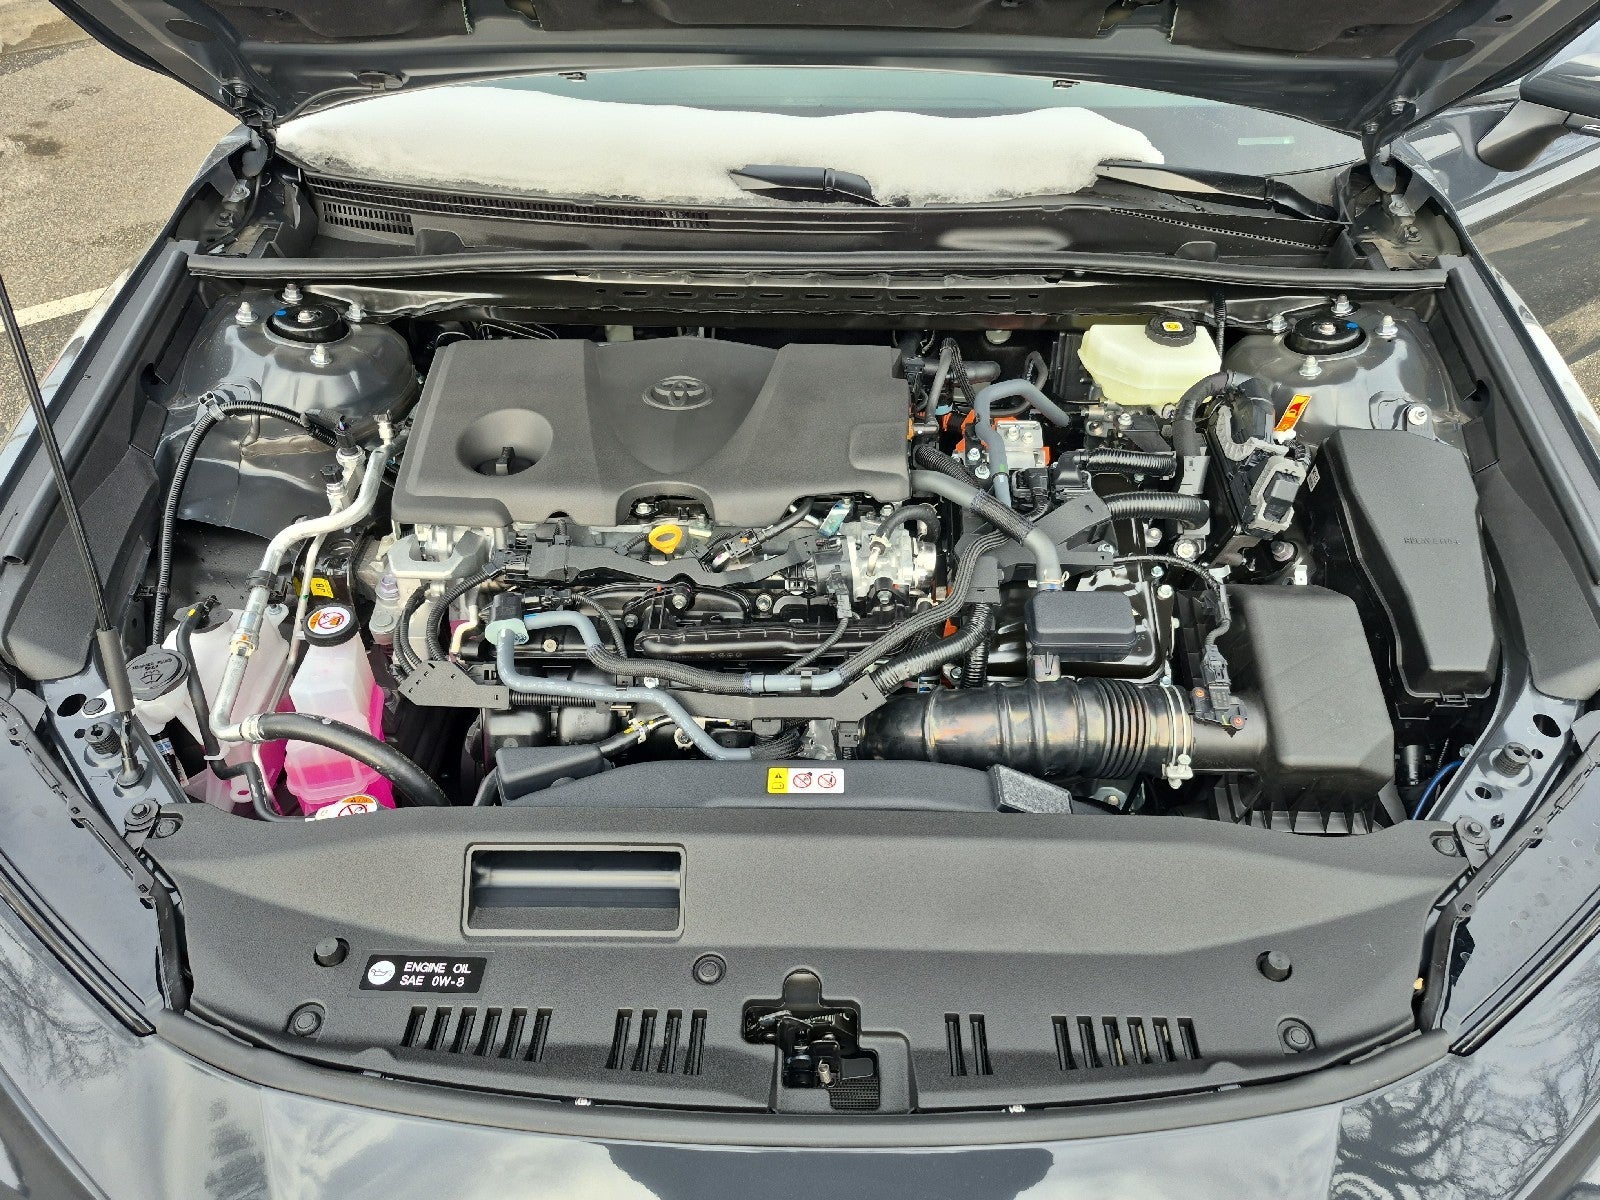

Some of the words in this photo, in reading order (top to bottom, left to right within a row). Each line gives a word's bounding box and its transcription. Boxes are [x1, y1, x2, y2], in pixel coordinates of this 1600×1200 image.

[404, 961, 447, 974] ENGINE
[452, 963, 472, 974] OIL
[399, 974, 425, 986] SAE
[431, 976, 465, 987] 0W-8
